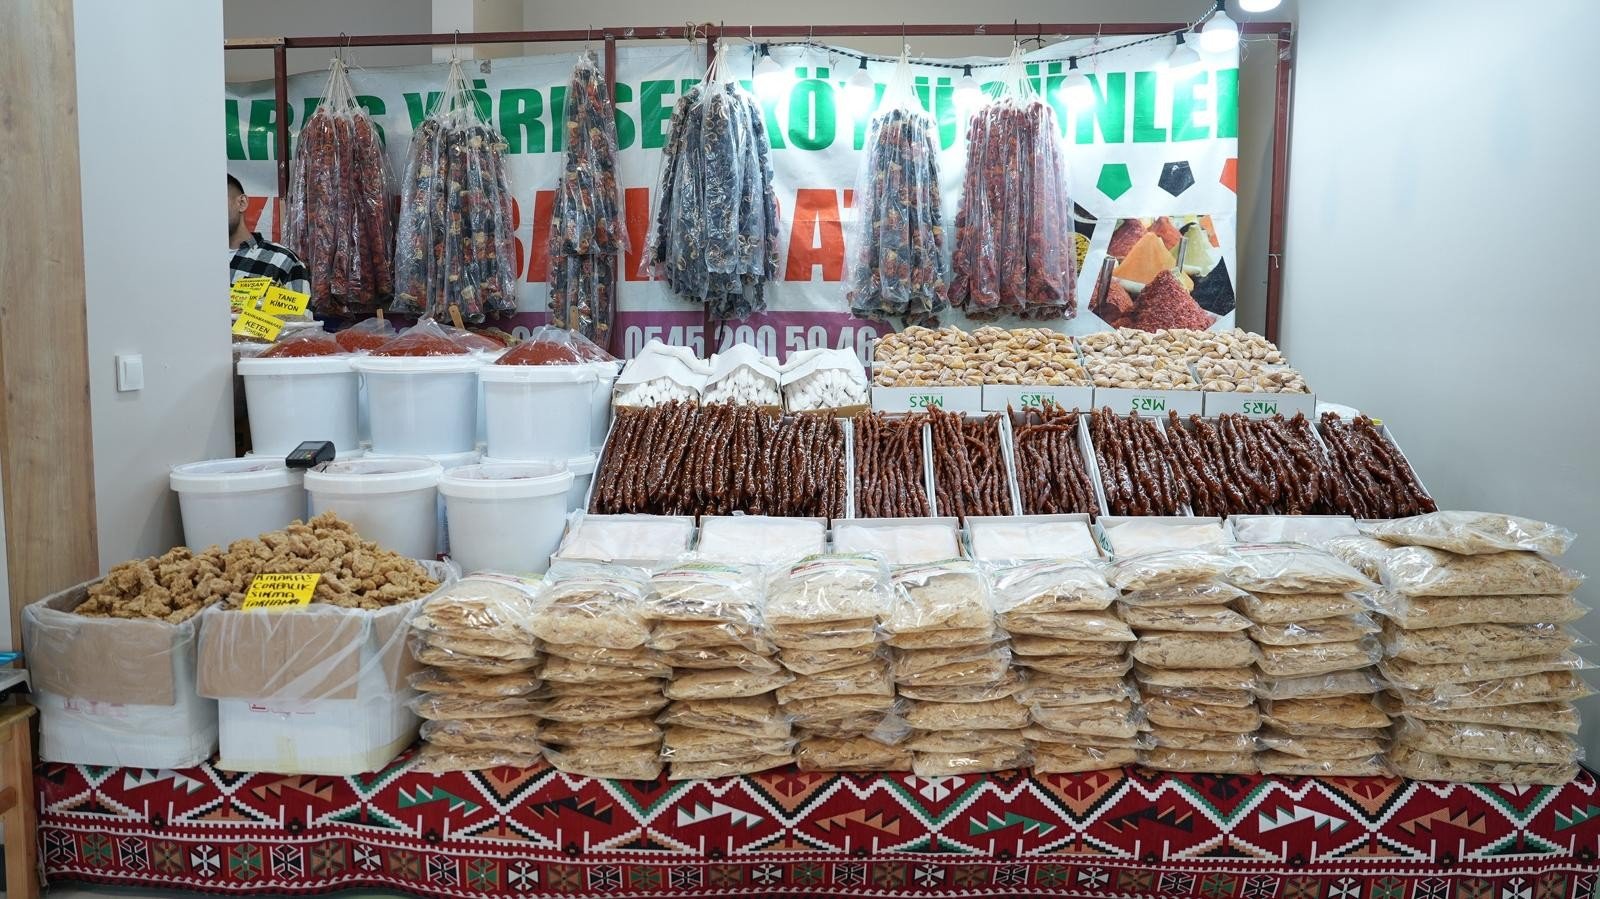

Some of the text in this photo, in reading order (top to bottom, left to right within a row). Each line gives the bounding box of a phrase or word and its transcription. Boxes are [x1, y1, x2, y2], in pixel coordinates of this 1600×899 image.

[278, 293, 297, 303] TANE
[270, 299, 299, 312] KİMYON
[245, 320, 270, 334] KETEN
[909, 395, 943, 408] MRS
[1131, 398, 1166, 411] MRS
[1242, 402, 1277, 415] MRS
